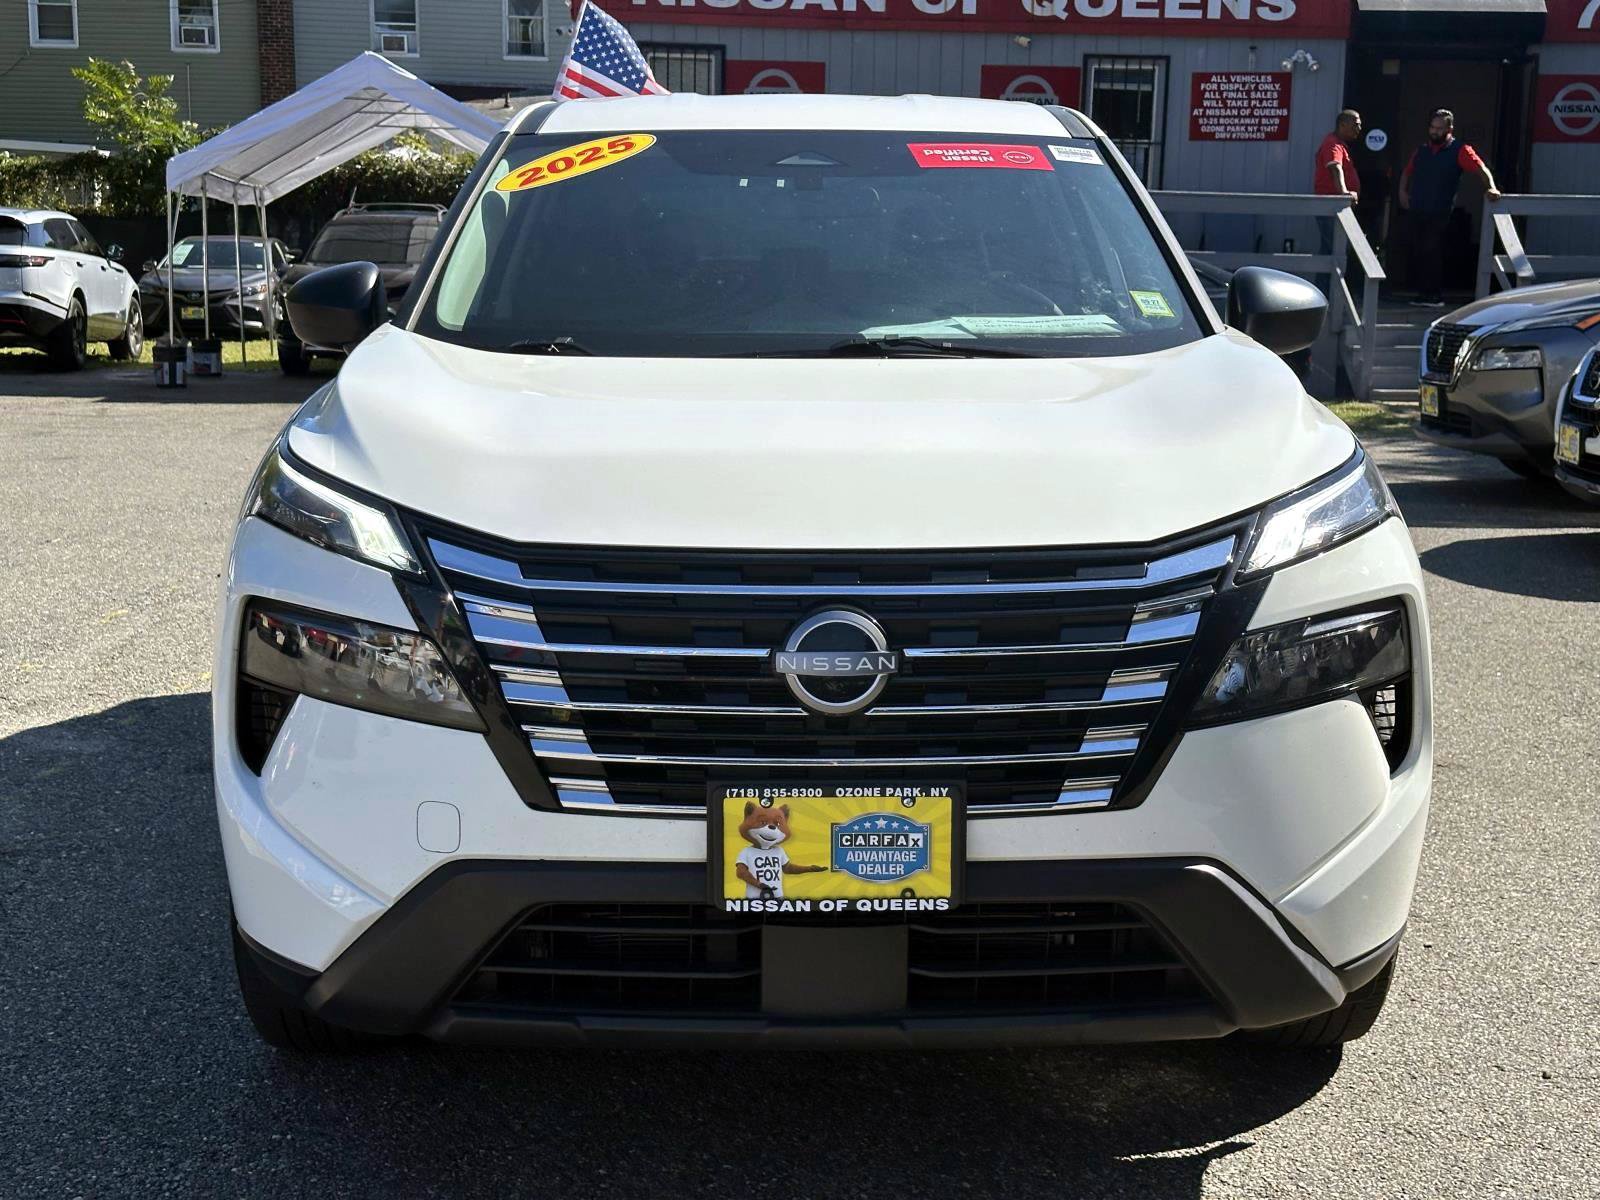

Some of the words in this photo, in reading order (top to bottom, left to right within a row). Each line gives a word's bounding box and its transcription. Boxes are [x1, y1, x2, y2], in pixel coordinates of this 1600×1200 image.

[1553, 104, 1600, 113] NISSAN
[516, 136, 636, 188] 2025
[780, 655, 896, 670] NISSAN
[726, 788, 759, 798] (718)
[763, 788, 823, 798] 835-8300
[835, 788, 881, 797] OZONE
[886, 788, 926, 798] PARK,
[930, 788, 949, 797] NY
[840, 834, 922, 848] CARFAX
[754, 856, 780, 868] CAR
[846, 850, 917, 862] ADVANTAGE
[858, 863, 904, 875] DEALER
[756, 869, 780, 882] FOX
[725, 900, 811, 912] NISSAN
[818, 900, 848, 912] OF
[856, 898, 950, 912] QUEENS
